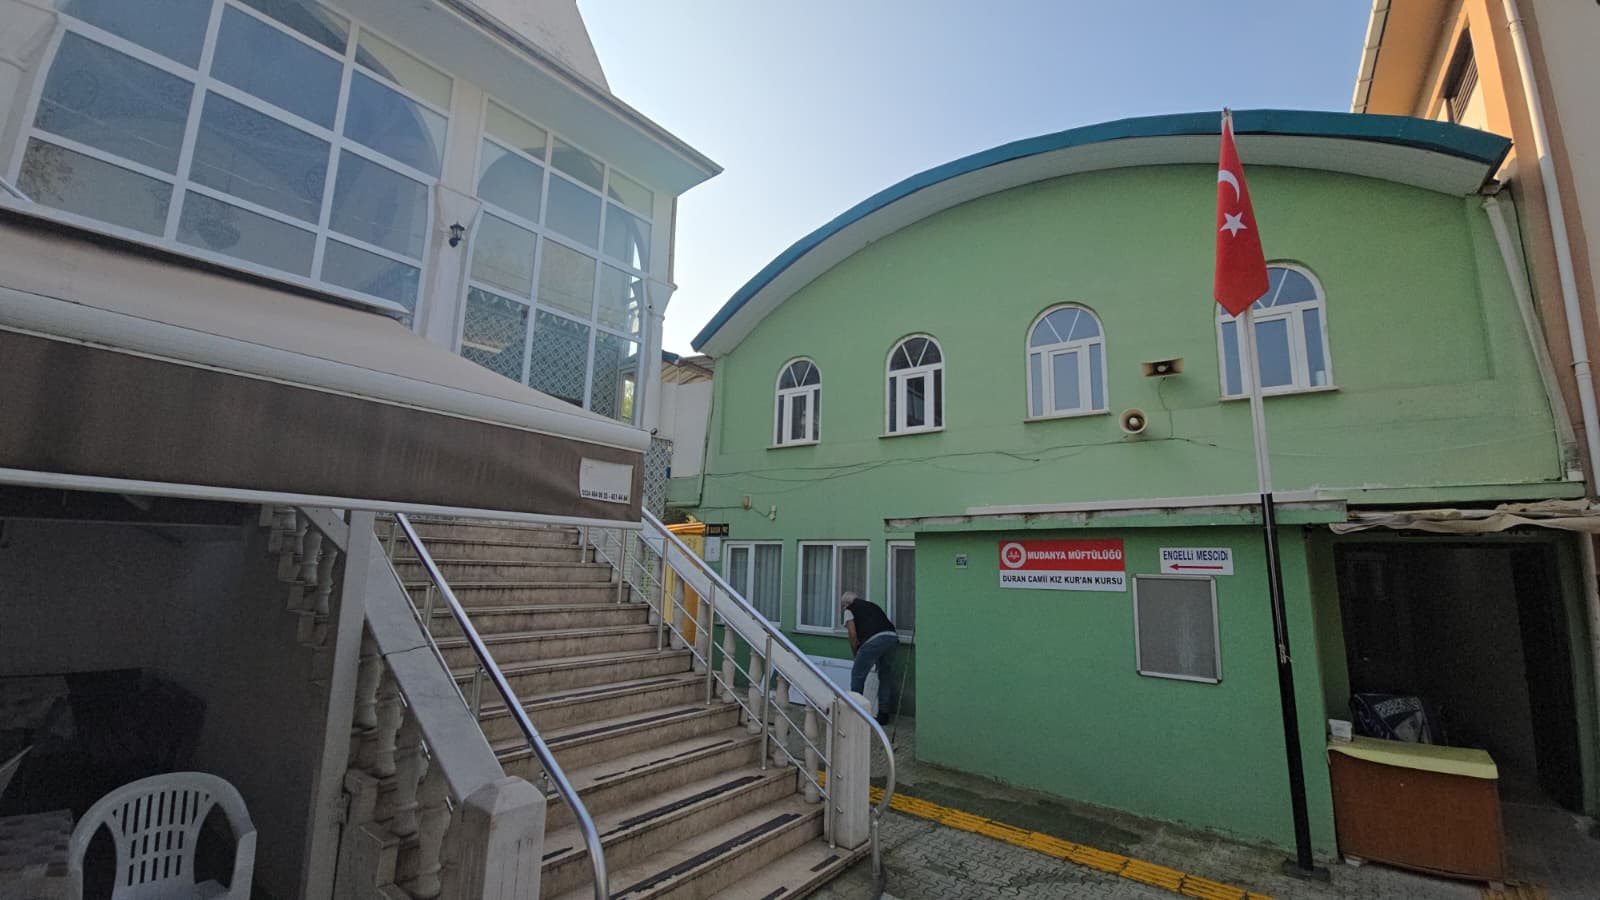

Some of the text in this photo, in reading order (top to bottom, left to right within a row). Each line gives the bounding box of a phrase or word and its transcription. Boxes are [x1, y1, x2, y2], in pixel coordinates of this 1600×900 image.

[1027, 549, 1122, 560] MUDANYA MÜFTÜLÜĞÜ
[1003, 575, 1026, 583] DURAN
[1050, 576, 1063, 584] KIZ
[1065, 576, 1093, 584] KUR'AN
[1095, 577, 1123, 585] KURSU
